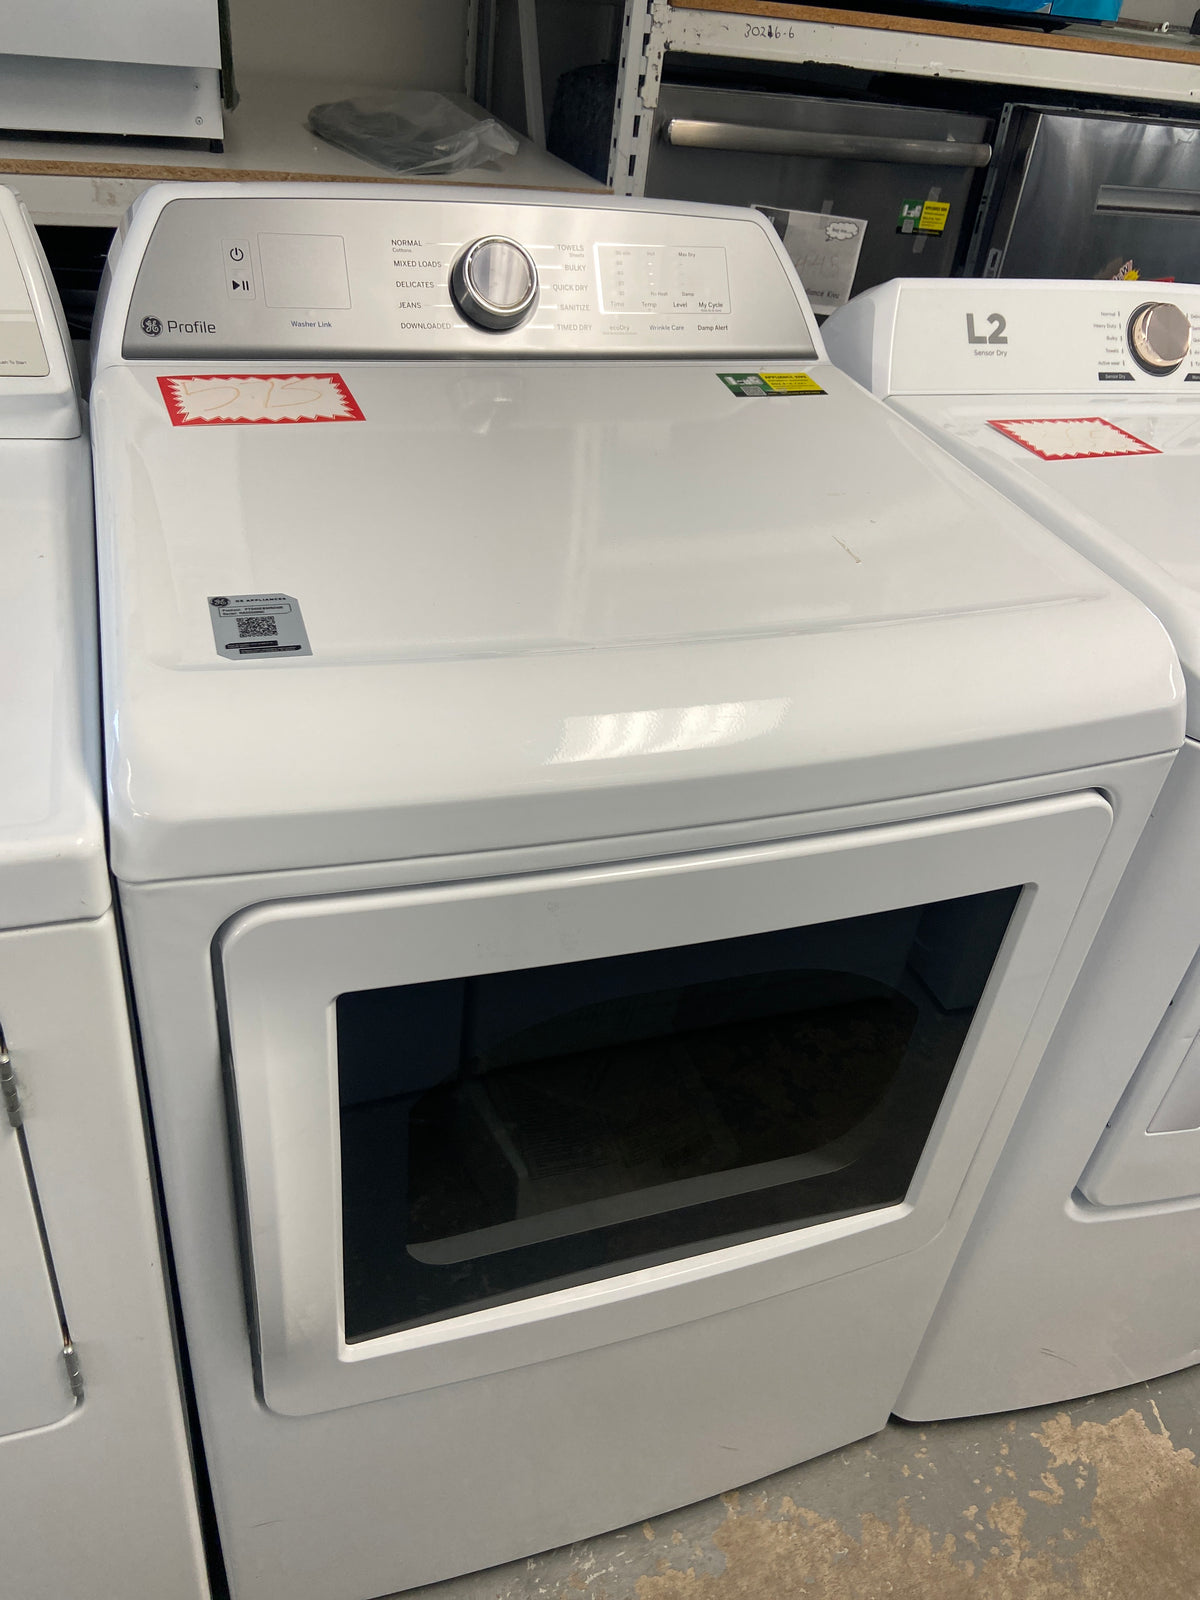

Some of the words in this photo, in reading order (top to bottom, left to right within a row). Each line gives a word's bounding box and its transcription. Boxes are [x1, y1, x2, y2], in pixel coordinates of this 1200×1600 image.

[391, 239, 423, 247] NORMAL
[557, 243, 584, 252] TOWELS
[393, 260, 417, 268] MIXED
[418, 260, 442, 268] LOADS
[396, 281, 435, 289] DELICATES
[552, 284, 574, 292] QUICK
[398, 302, 422, 310] JEANS
[560, 304, 591, 312] SANITIZE
[641, 301, 658, 309] Temp
[698, 302, 707, 310] My
[707, 302, 724, 310] Cycle
[167, 321, 216, 334] Profile
[290, 320, 316, 328] Washer
[317, 320, 332, 328] Link
[400, 322, 452, 330] DOWNLOADED
[698, 324, 714, 332] Damp
[714, 324, 728, 332] Alert
[966, 312, 1008, 344] L2
[996, 349, 1008, 358] Dry
